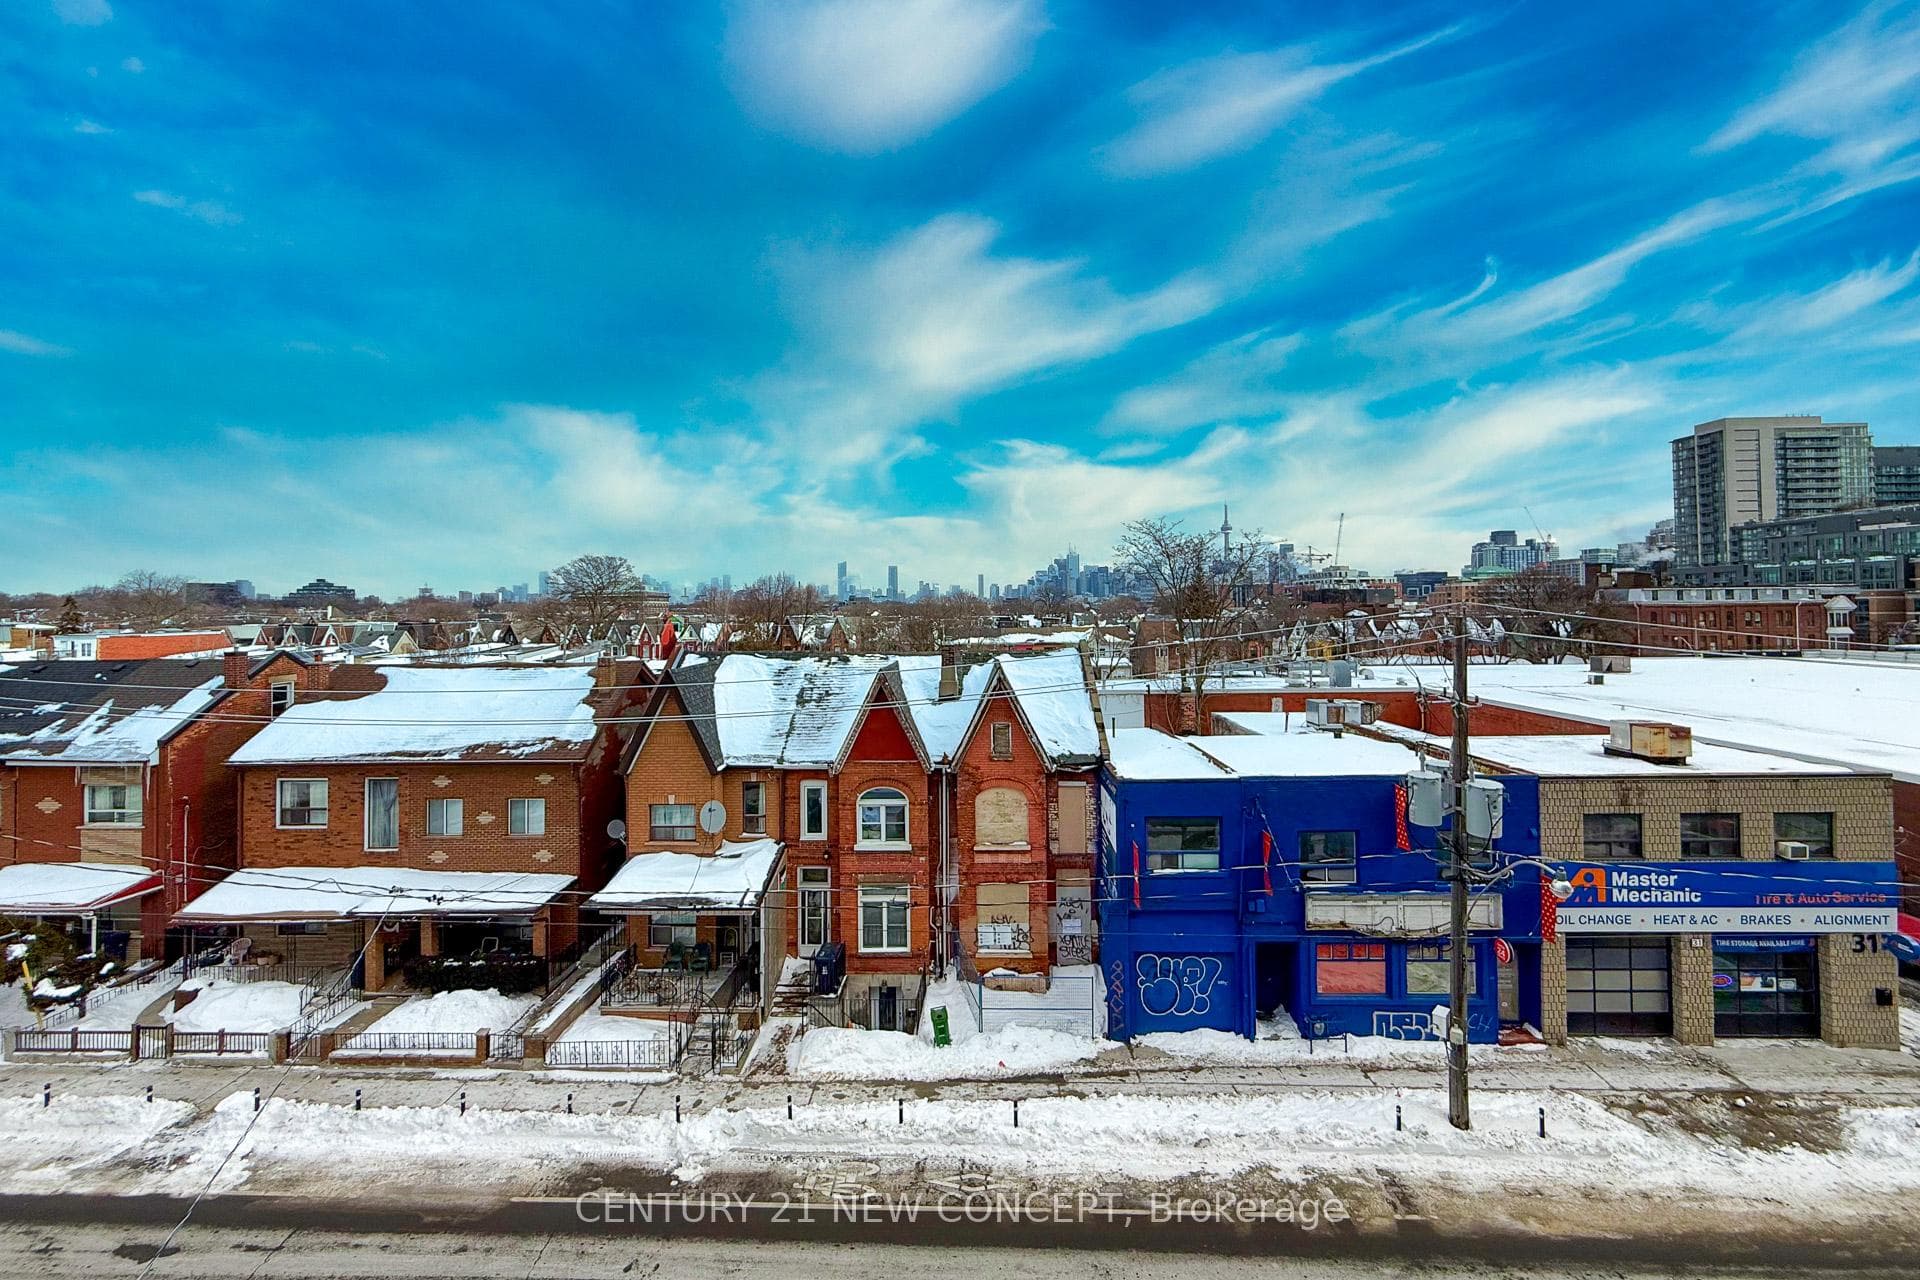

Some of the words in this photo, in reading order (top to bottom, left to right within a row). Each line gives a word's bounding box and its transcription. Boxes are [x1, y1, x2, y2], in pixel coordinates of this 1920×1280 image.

[1611, 872, 1678, 887] Master
[1611, 888, 1702, 903] Mechanic
[1832, 891, 1887, 903] Service
[1555, 915, 1575, 925] OIL
[1578, 914, 1632, 925] CHANGE
[1653, 915, 1686, 925] HEAT
[1688, 915, 1698, 925] &
[1700, 915, 1719, 925] AC
[1740, 914, 1792, 925] BRAKES
[1814, 914, 1890, 925] ALIGNMENT
